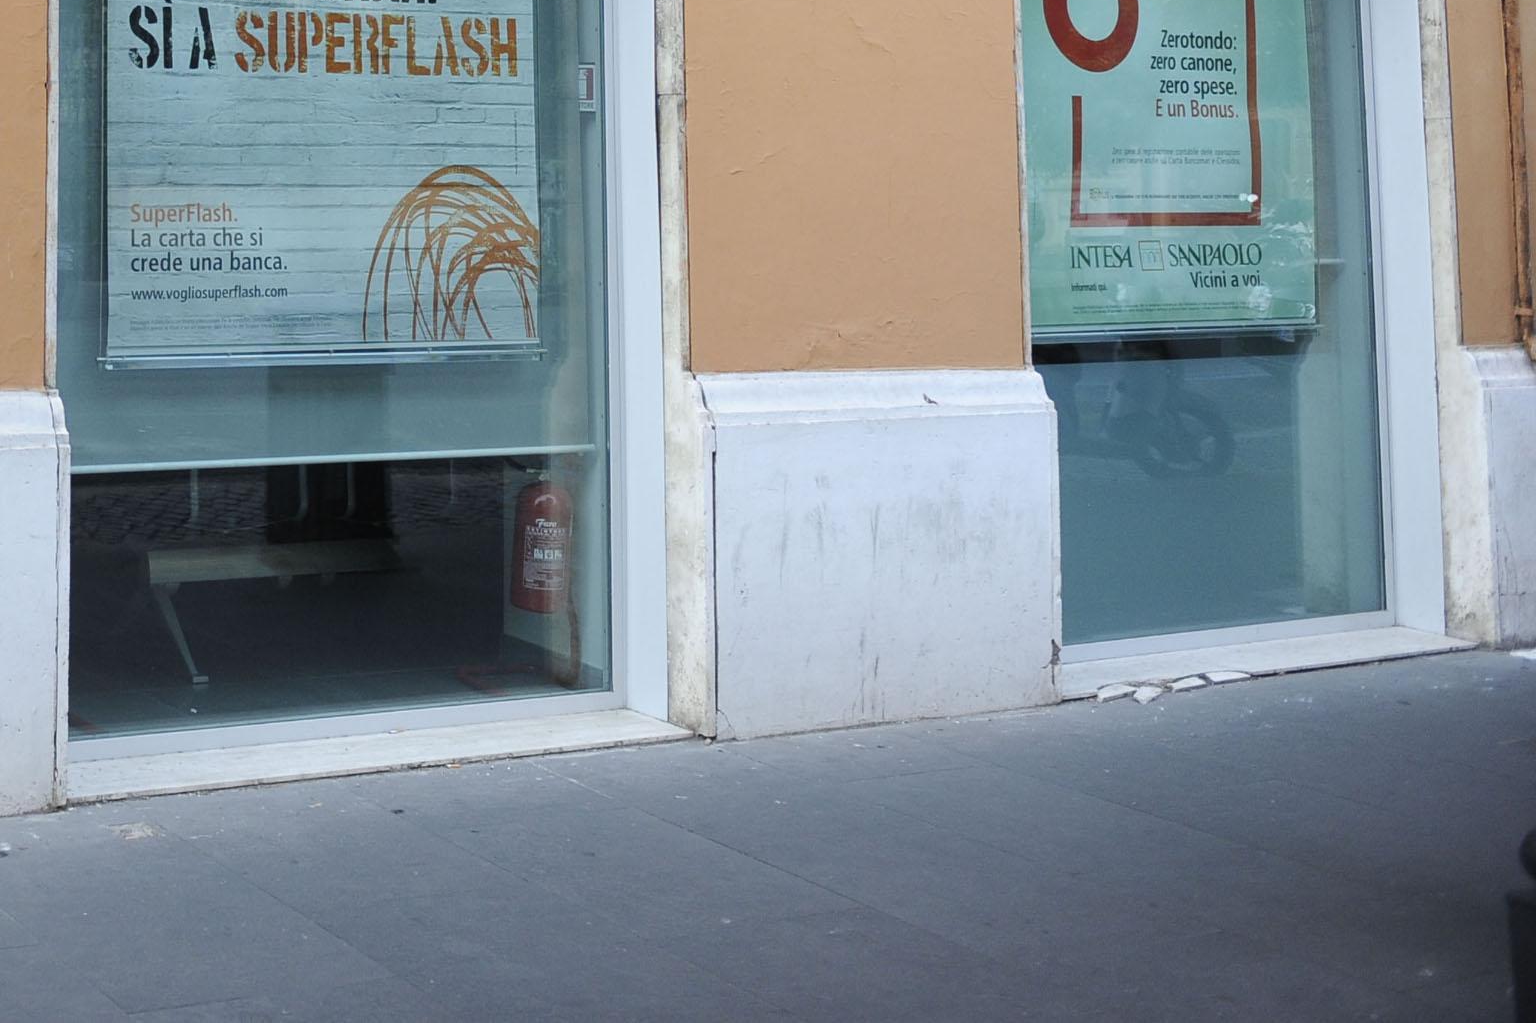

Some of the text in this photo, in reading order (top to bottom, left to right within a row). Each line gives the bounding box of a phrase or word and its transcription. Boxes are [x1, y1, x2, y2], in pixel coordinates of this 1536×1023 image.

[189, 6, 218, 70] A
[233, 10, 519, 77] SUPERFLASH
[1160, 29, 1237, 50] Zerotondo:
[1150, 56, 1237, 76] zero canone,
[1159, 79, 1238, 100] zero spese.
[1155, 98, 1240, 119] E un Bonus.
[129, 202, 239, 227] SuperFlash.
[131, 227, 263, 248] La carta che si
[130, 250, 288, 273] crede una banca.
[1070, 242, 1263, 269] INTESA SANPAOLO
[1189, 269, 1227, 288] Vicini
[1230, 274, 1240, 288] a
[131, 284, 289, 303] www.vogliosuperflash.com
